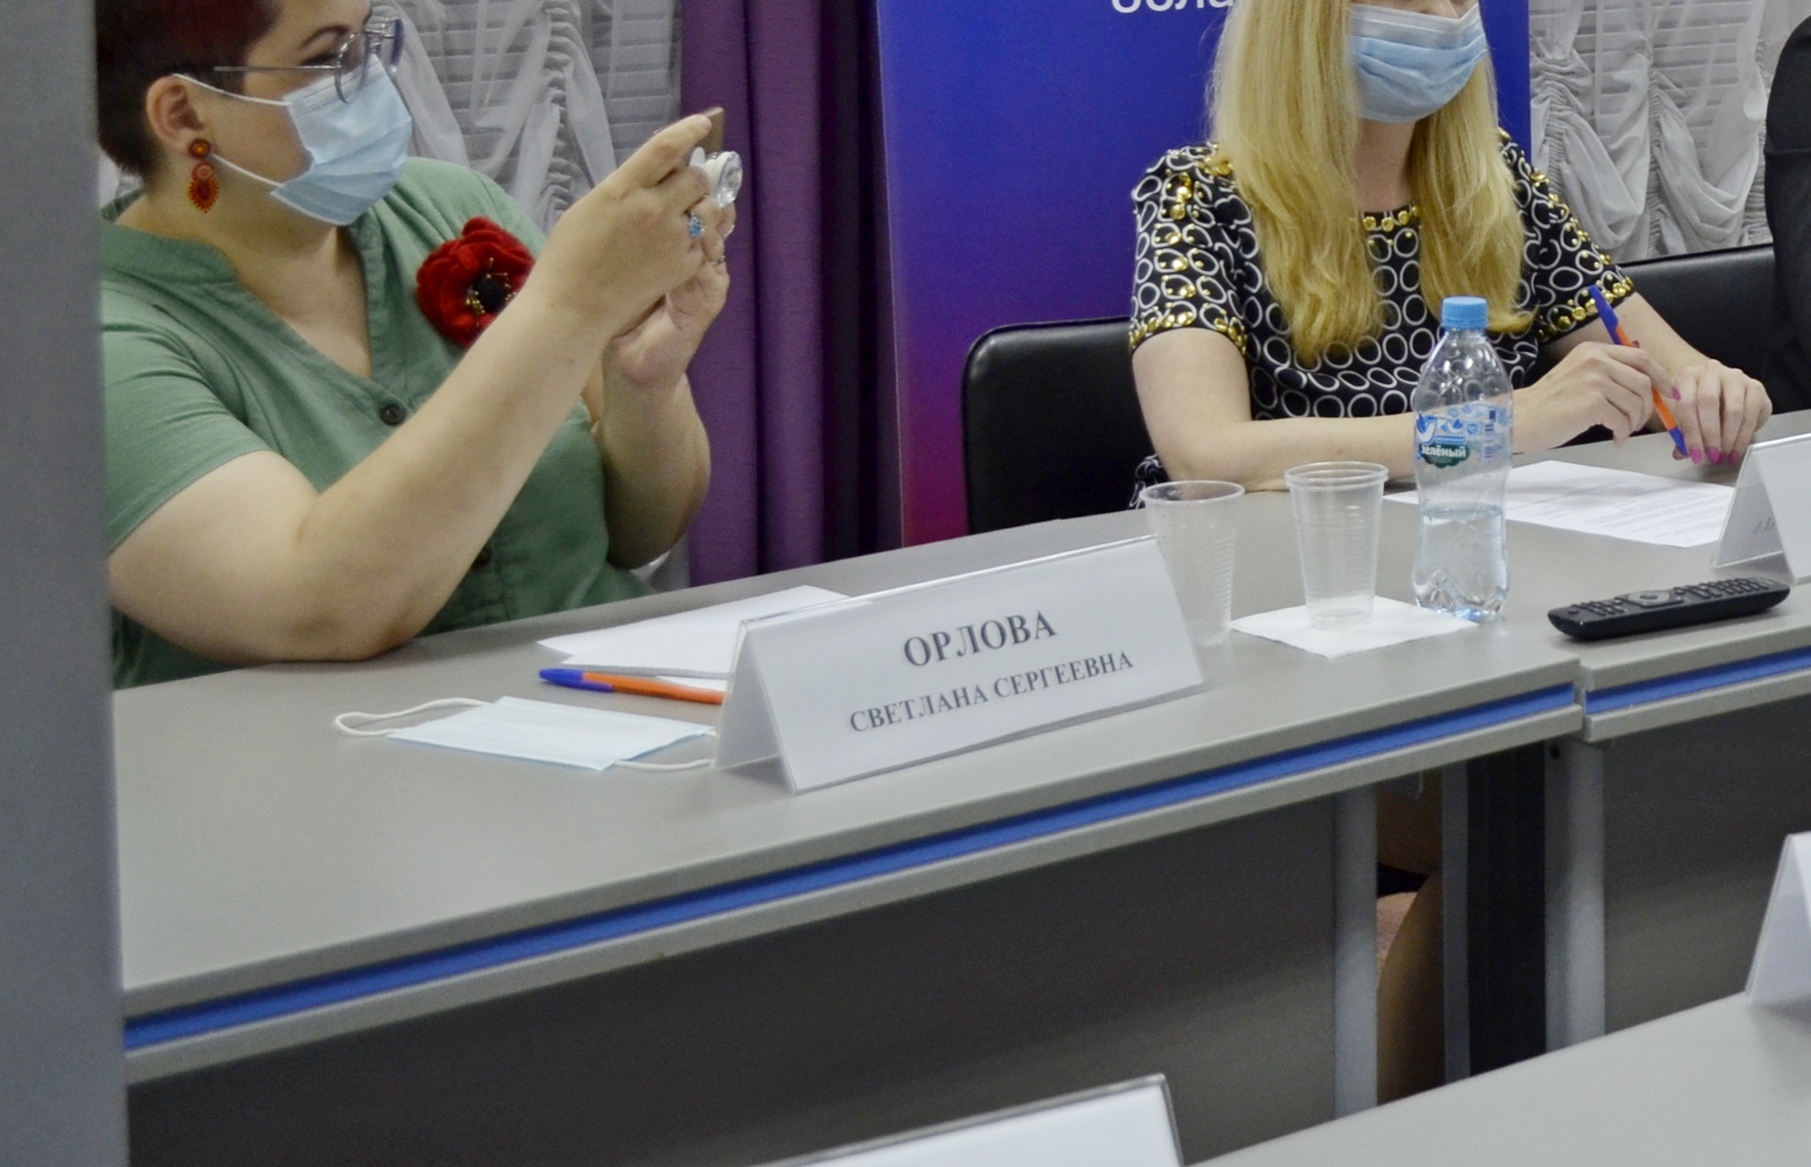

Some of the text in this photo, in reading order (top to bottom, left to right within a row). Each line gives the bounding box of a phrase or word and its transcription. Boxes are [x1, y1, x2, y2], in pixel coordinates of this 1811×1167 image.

[904, 610, 1057, 667] ОРЛОВА
[849, 651, 1133, 732] СВЕТЛАНА СЕРГЕЕВНА
